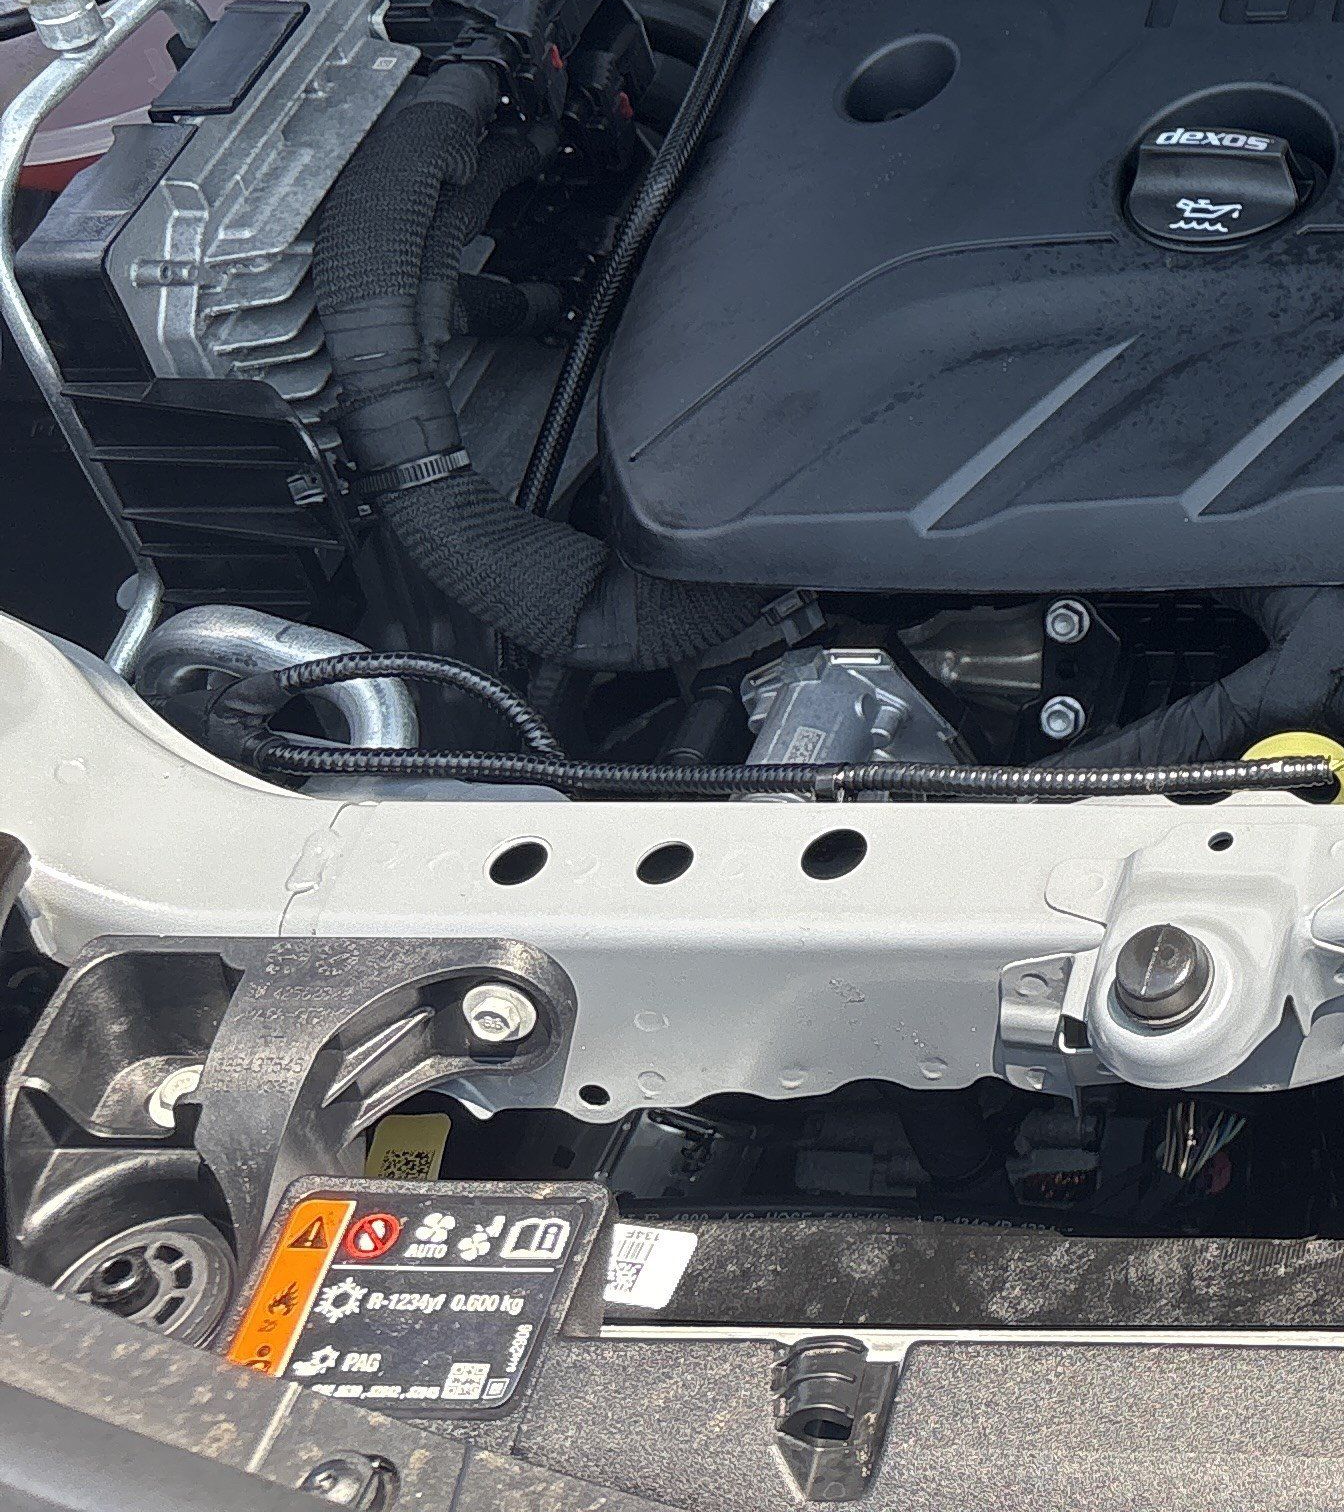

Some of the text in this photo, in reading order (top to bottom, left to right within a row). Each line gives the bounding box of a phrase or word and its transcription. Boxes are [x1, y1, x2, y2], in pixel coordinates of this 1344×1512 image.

[1155, 127, 1271, 151] dexos
[404, 1243, 448, 1259] AUTO
[500, 1294, 525, 1316] kg
[341, 1352, 382, 1373] PAG
